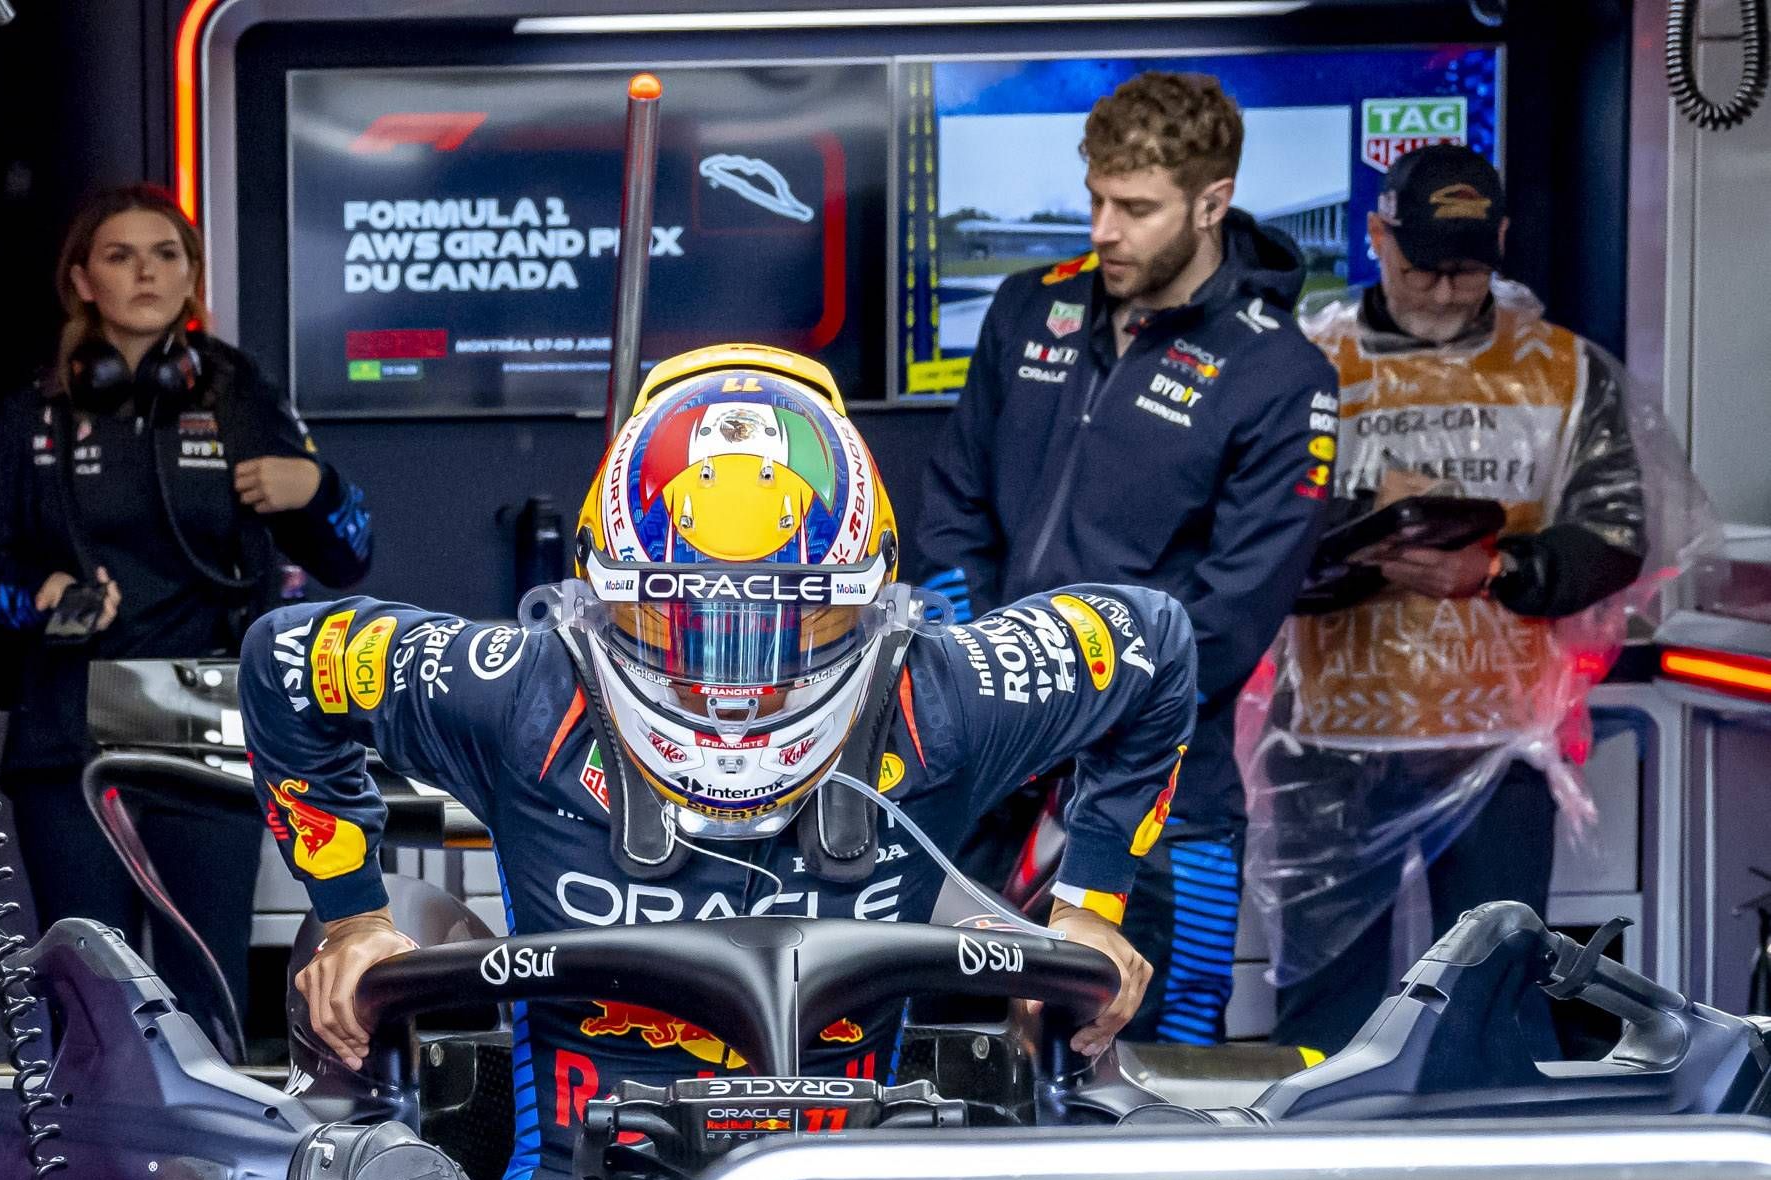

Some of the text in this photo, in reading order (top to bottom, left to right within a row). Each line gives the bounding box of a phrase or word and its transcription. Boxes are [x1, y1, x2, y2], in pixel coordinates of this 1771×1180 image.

[1371, 106, 1455, 131] TAG
[343, 197, 570, 229] FORMULA 1
[345, 226, 684, 261] AWS GRAND PX
[344, 261, 579, 292] DU CANADA
[1150, 373, 1203, 408] BYBIT
[605, 580, 625, 591] Mobil
[645, 573, 825, 600] ORACLE
[836, 583, 859, 595] Mobil
[316, 618, 349, 705] PIRELLI
[354, 632, 377, 695] RAUCH
[392, 645, 415, 693] Sui
[710, 687, 764, 696] BANORTE
[650, 736, 686, 763] KitKat
[711, 739, 764, 749] BANORTE
[706, 781, 785, 799] inter.mx
[513, 946, 557, 978] Sui
[988, 940, 1024, 972] Sui
[708, 1079, 855, 1096] ORACLE
[706, 1120, 753, 1130] Red Bull
[707, 1107, 849, 1134] ORACLE 11
